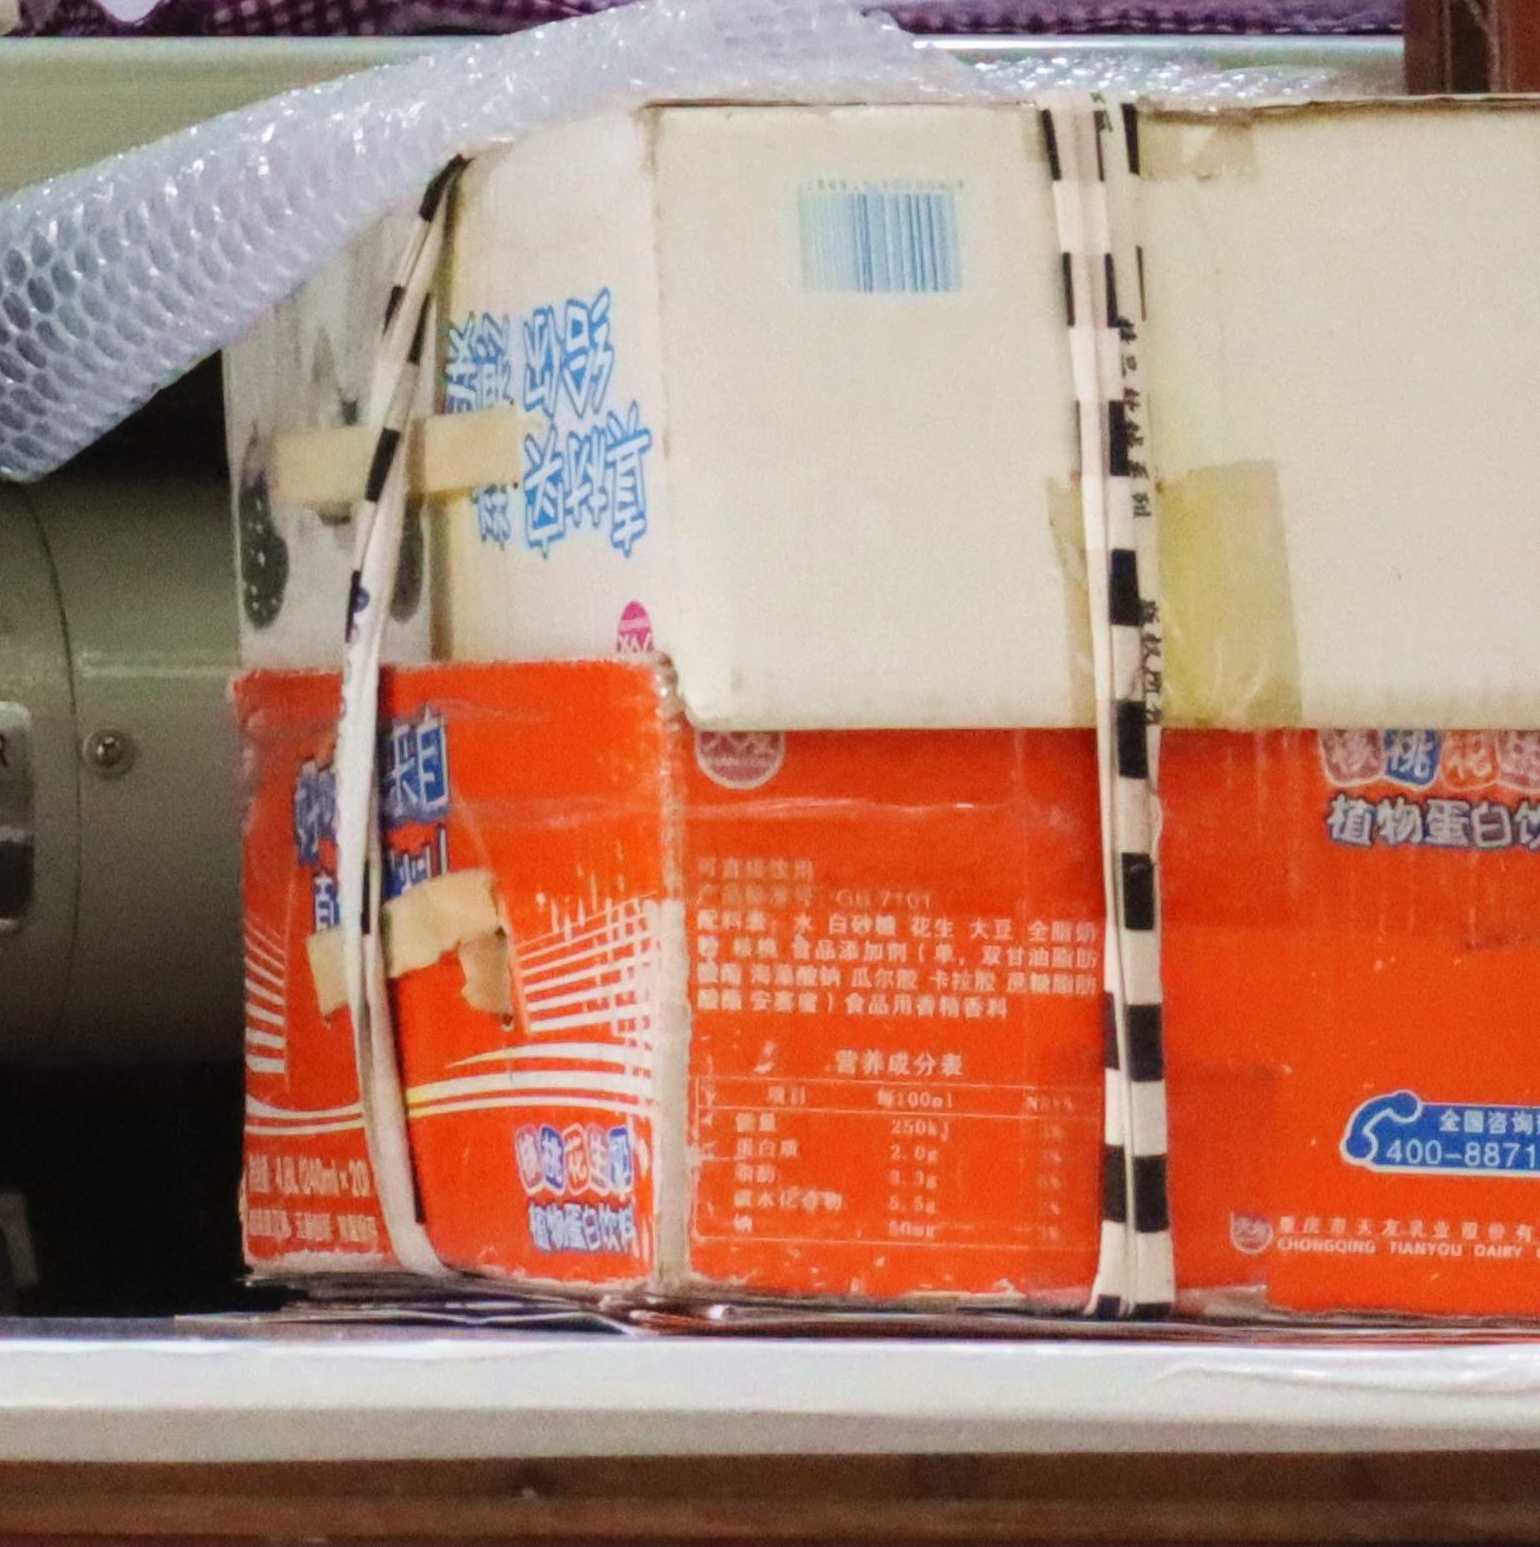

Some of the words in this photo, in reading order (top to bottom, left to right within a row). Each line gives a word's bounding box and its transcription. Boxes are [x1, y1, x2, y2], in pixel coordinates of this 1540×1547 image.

[794, 913, 814, 934] 水
[910, 917, 954, 939] 花生
[970, 919, 1013, 941] 大豆
[835, 1050, 963, 1077] 营养成分表
[1438, 1109, 1540, 1136] 全国咨询
[1385, 1139, 1538, 1168] 400-8871
[1276, 1238, 1377, 1255] CHONGQING
[1389, 1241, 1463, 1258] TIANYOU
[1473, 1243, 1523, 1258] DAIRY
